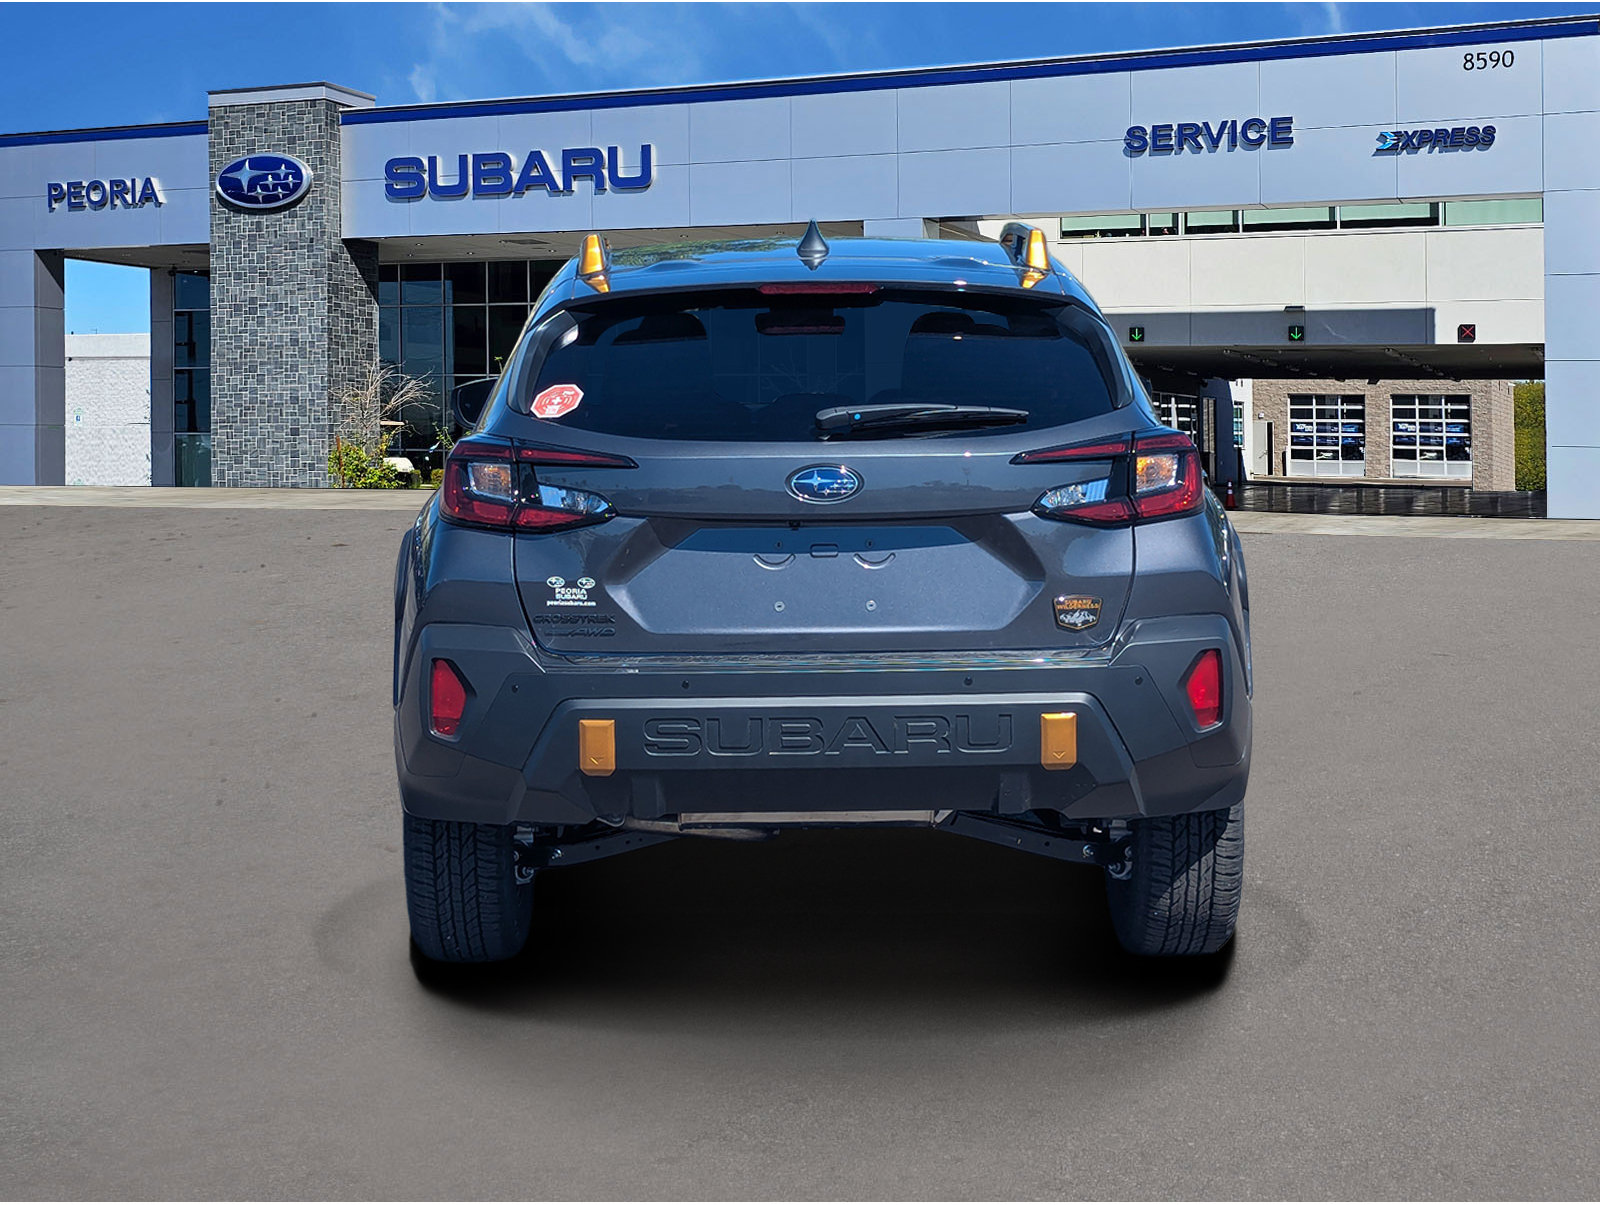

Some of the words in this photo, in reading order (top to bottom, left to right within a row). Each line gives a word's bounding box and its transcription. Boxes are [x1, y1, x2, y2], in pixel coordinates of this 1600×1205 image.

[1463, 50, 1515, 71] 8590
[1124, 116, 1294, 154] SERVICE
[1375, 125, 1497, 152] EXPRESS
[384, 144, 653, 201] SUBARU
[47, 177, 164, 212] PEORIA
[533, 614, 616, 625] CROSSTREK
[568, 627, 616, 637] AWD
[643, 714, 1013, 757] SUBARU
